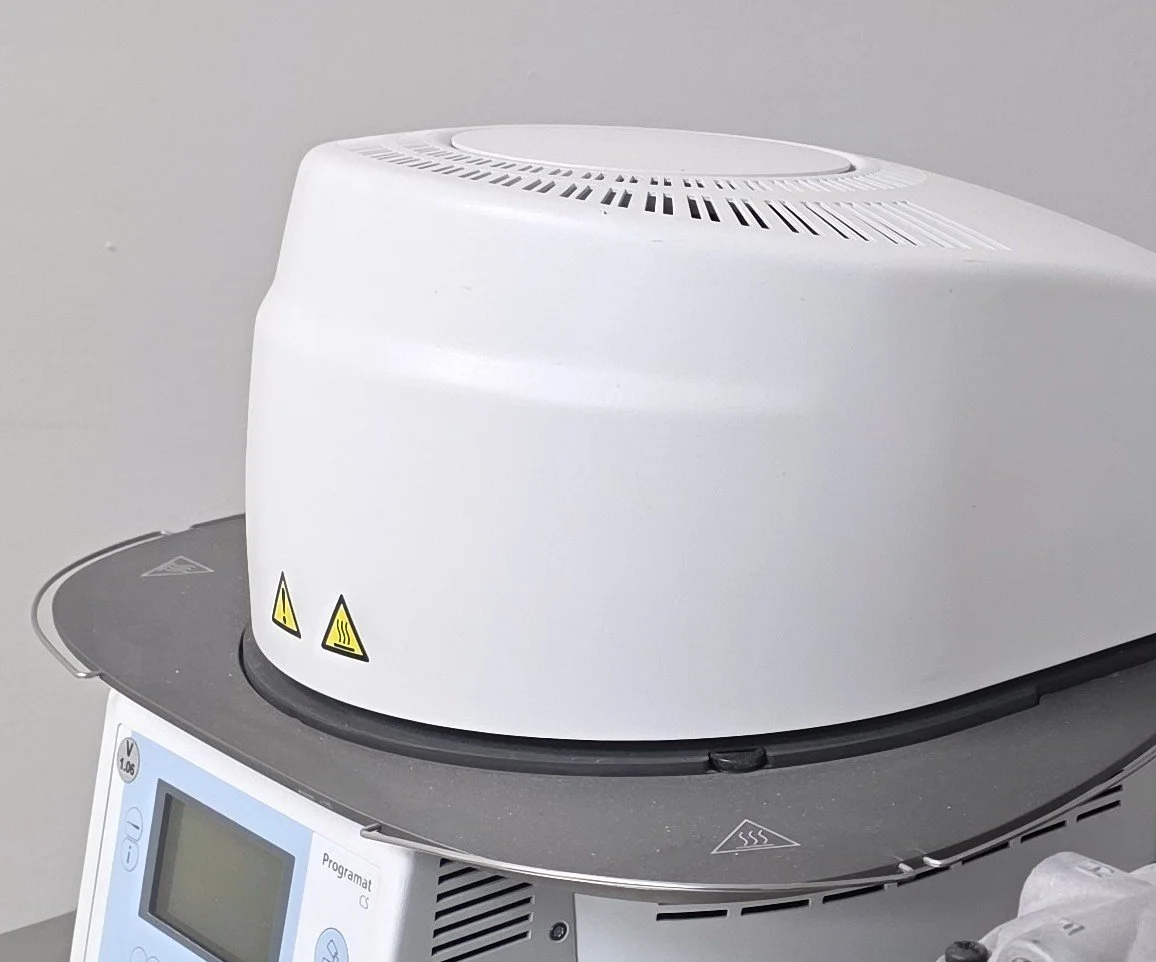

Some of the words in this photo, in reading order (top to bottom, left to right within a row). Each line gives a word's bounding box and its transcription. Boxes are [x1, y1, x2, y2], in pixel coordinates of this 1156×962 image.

[126, 740, 134, 757] V
[119, 757, 136, 776] 1.06
[322, 852, 372, 892] Programat
